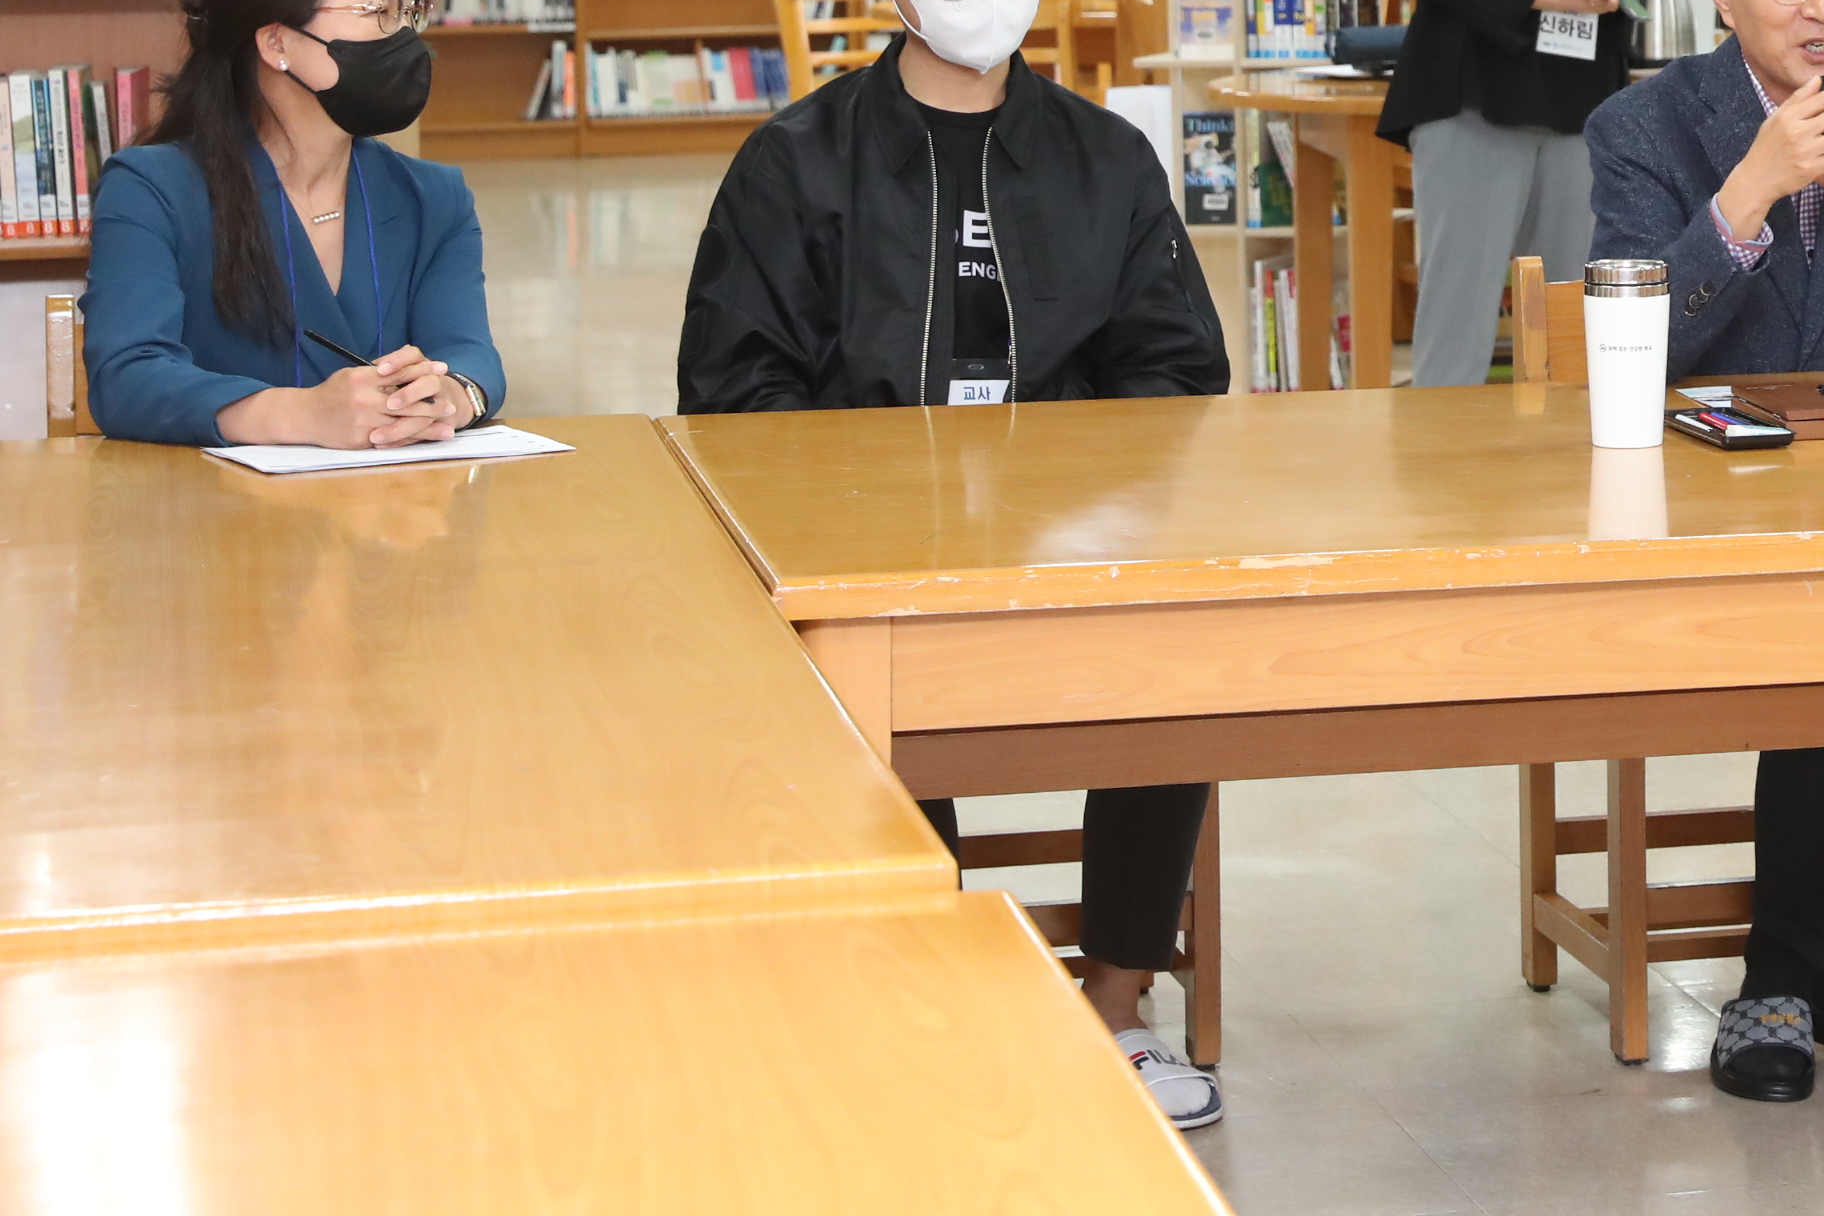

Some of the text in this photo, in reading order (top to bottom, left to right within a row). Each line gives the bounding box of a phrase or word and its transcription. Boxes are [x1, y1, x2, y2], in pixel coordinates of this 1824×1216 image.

[1540, 15, 1593, 40] 신하림
[963, 386, 991, 401] 교사
[1129, 1048, 1188, 1071] FILA
